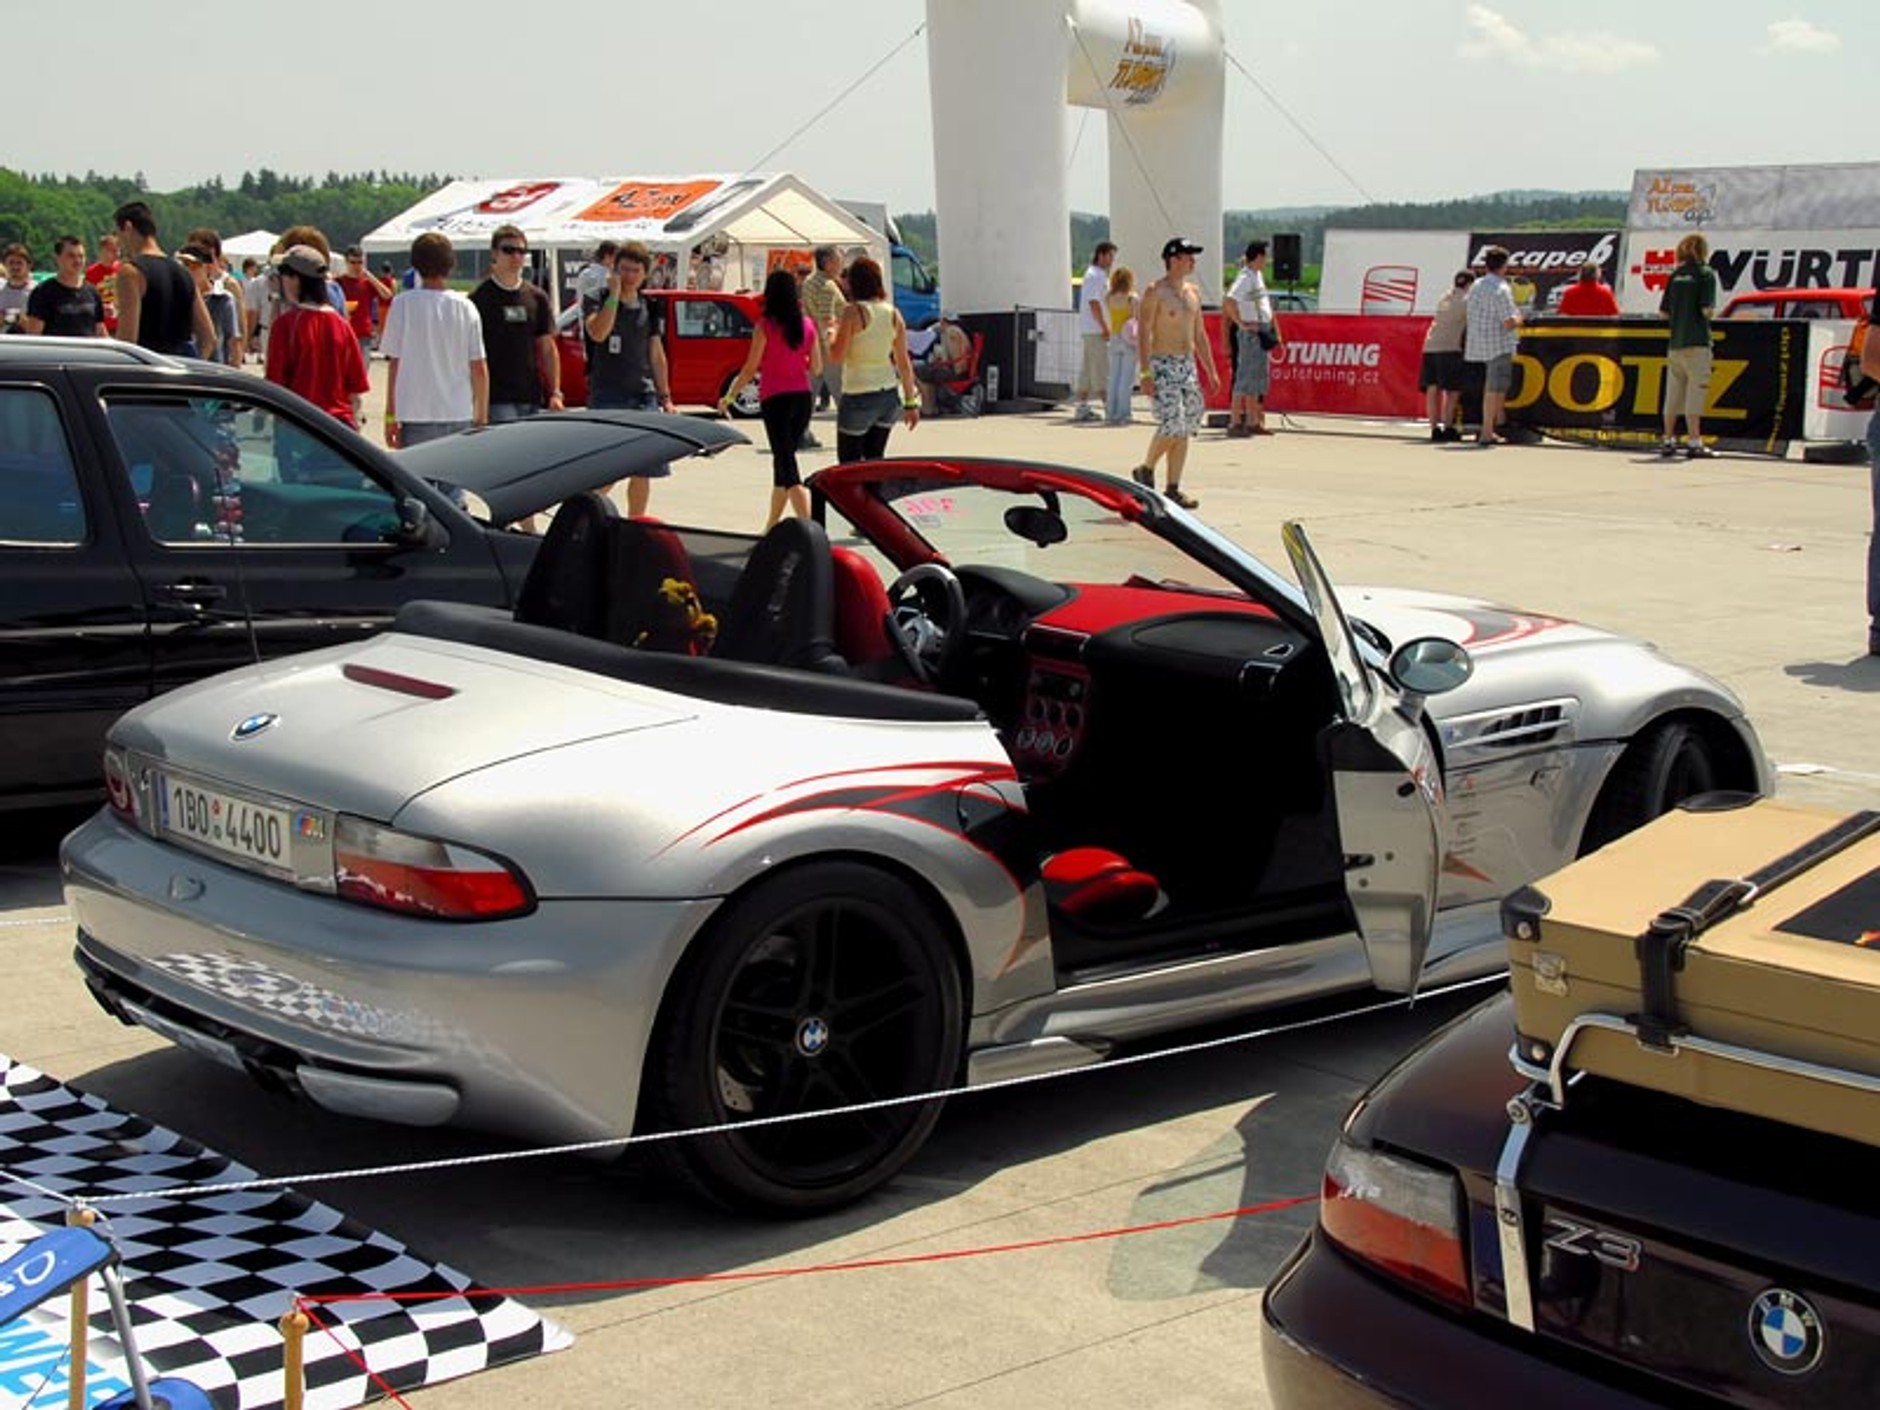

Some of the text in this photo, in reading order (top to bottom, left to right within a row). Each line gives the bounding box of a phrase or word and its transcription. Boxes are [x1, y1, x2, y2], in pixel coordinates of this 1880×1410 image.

[1471, 234, 1616, 271] Ecape6
[1708, 249, 1880, 292] WÜRT
[226, 804, 282, 859] 4400
[1543, 1219, 1642, 1272] Z3
